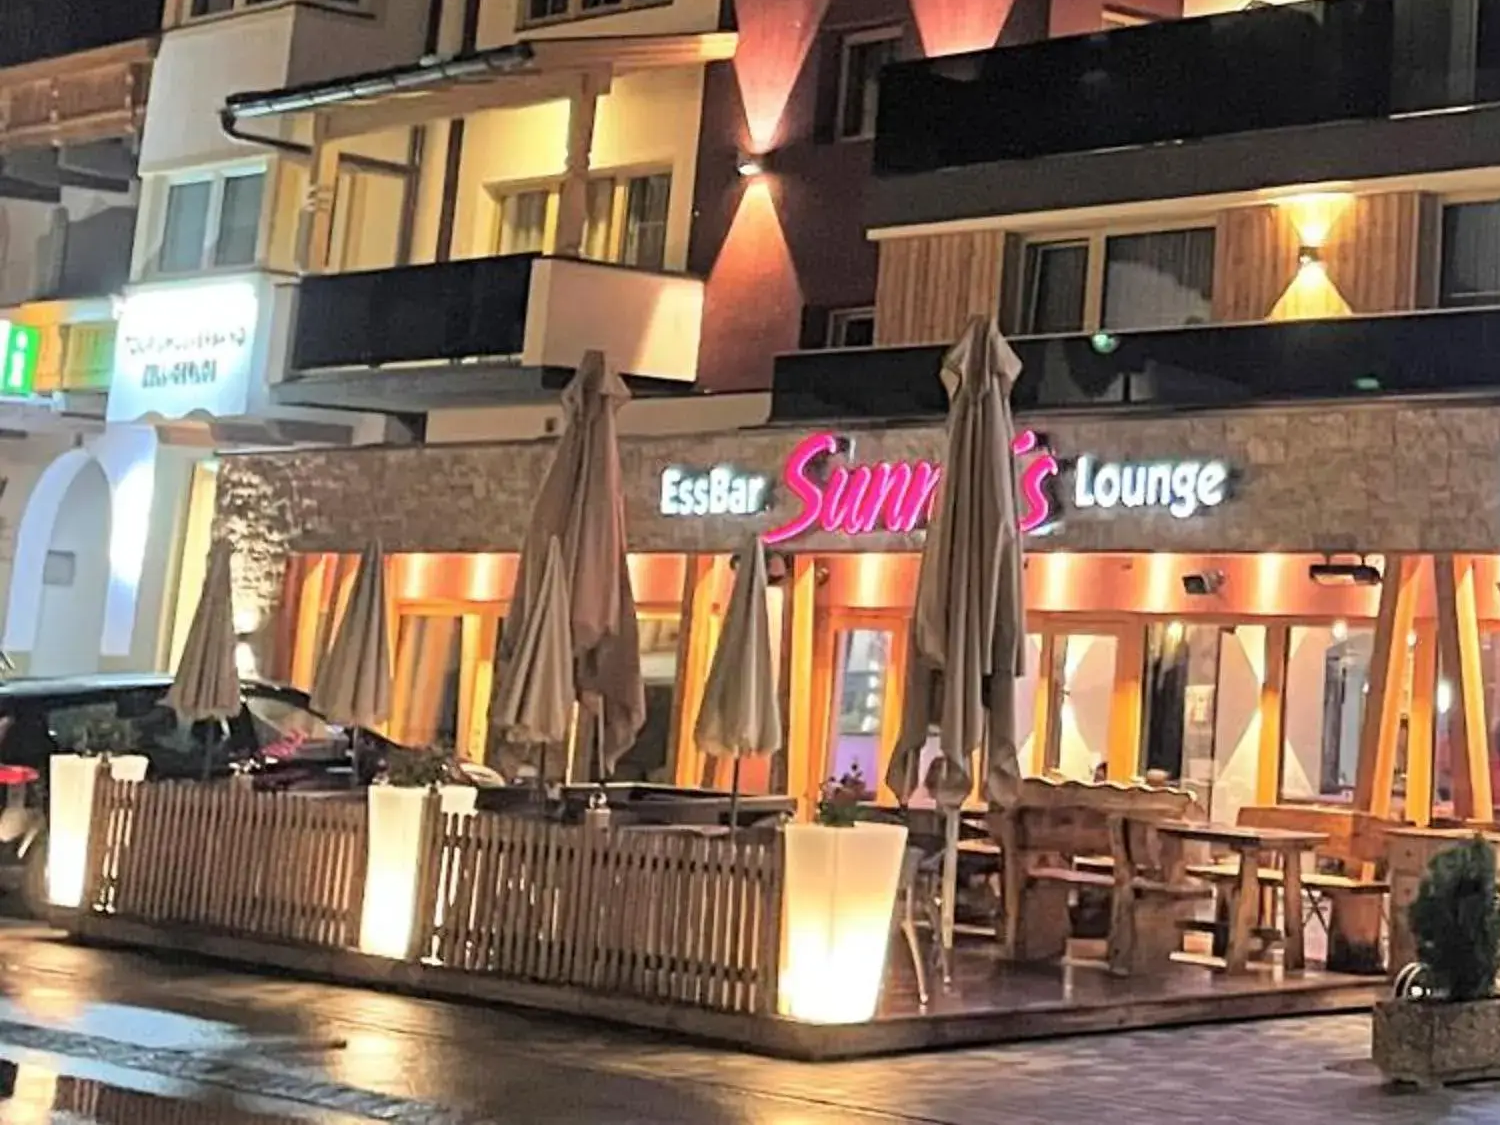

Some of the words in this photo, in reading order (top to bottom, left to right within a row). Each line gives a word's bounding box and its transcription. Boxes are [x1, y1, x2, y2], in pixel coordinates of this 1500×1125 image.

[660, 467, 766, 515] EssBar
[761, 430, 1058, 543] Sunn's
[1075, 453, 1227, 518] Lounge
